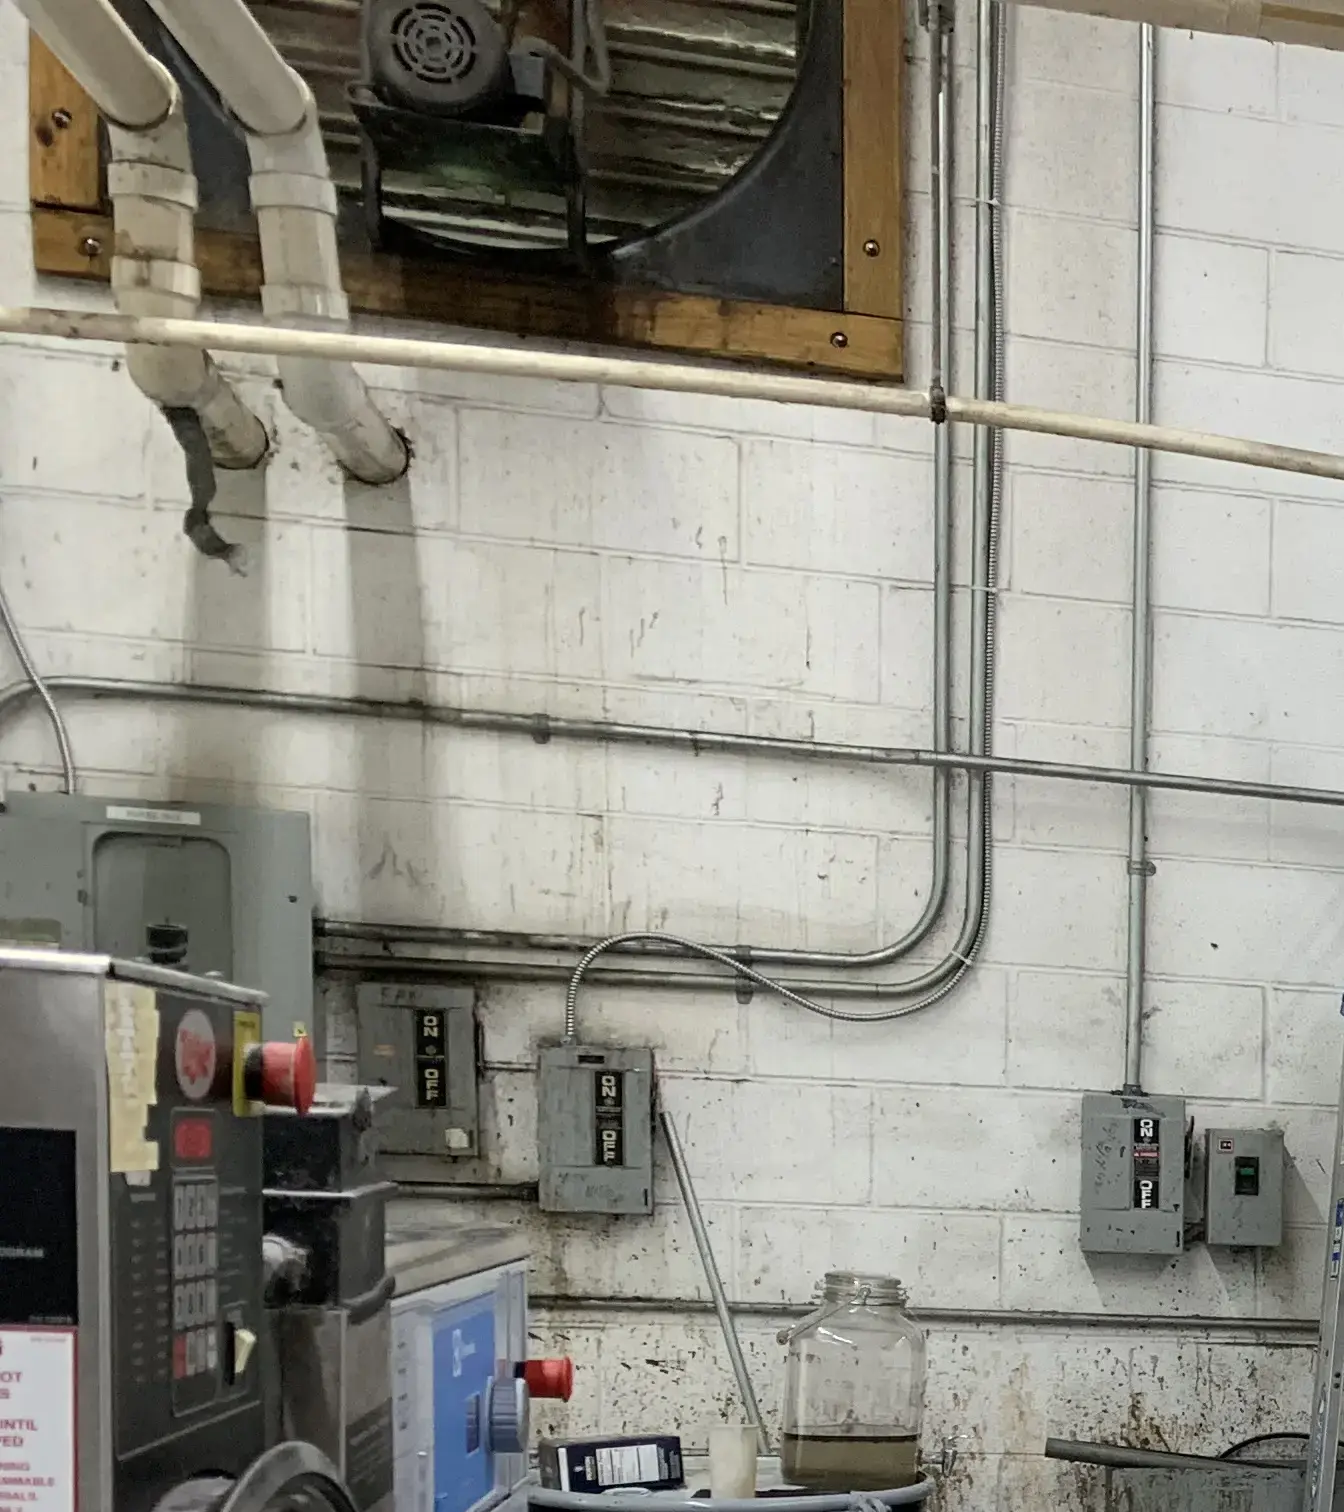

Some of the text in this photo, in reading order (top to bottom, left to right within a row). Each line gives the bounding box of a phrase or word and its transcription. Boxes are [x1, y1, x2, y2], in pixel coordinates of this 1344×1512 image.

[424, 1015, 439, 1037] ON
[424, 1068, 439, 1100] OFF
[601, 1075, 616, 1097] ON
[1140, 1119, 1154, 1137] ON
[602, 1130, 616, 1162] OFF
[1140, 1180, 1153, 1209] OFF
